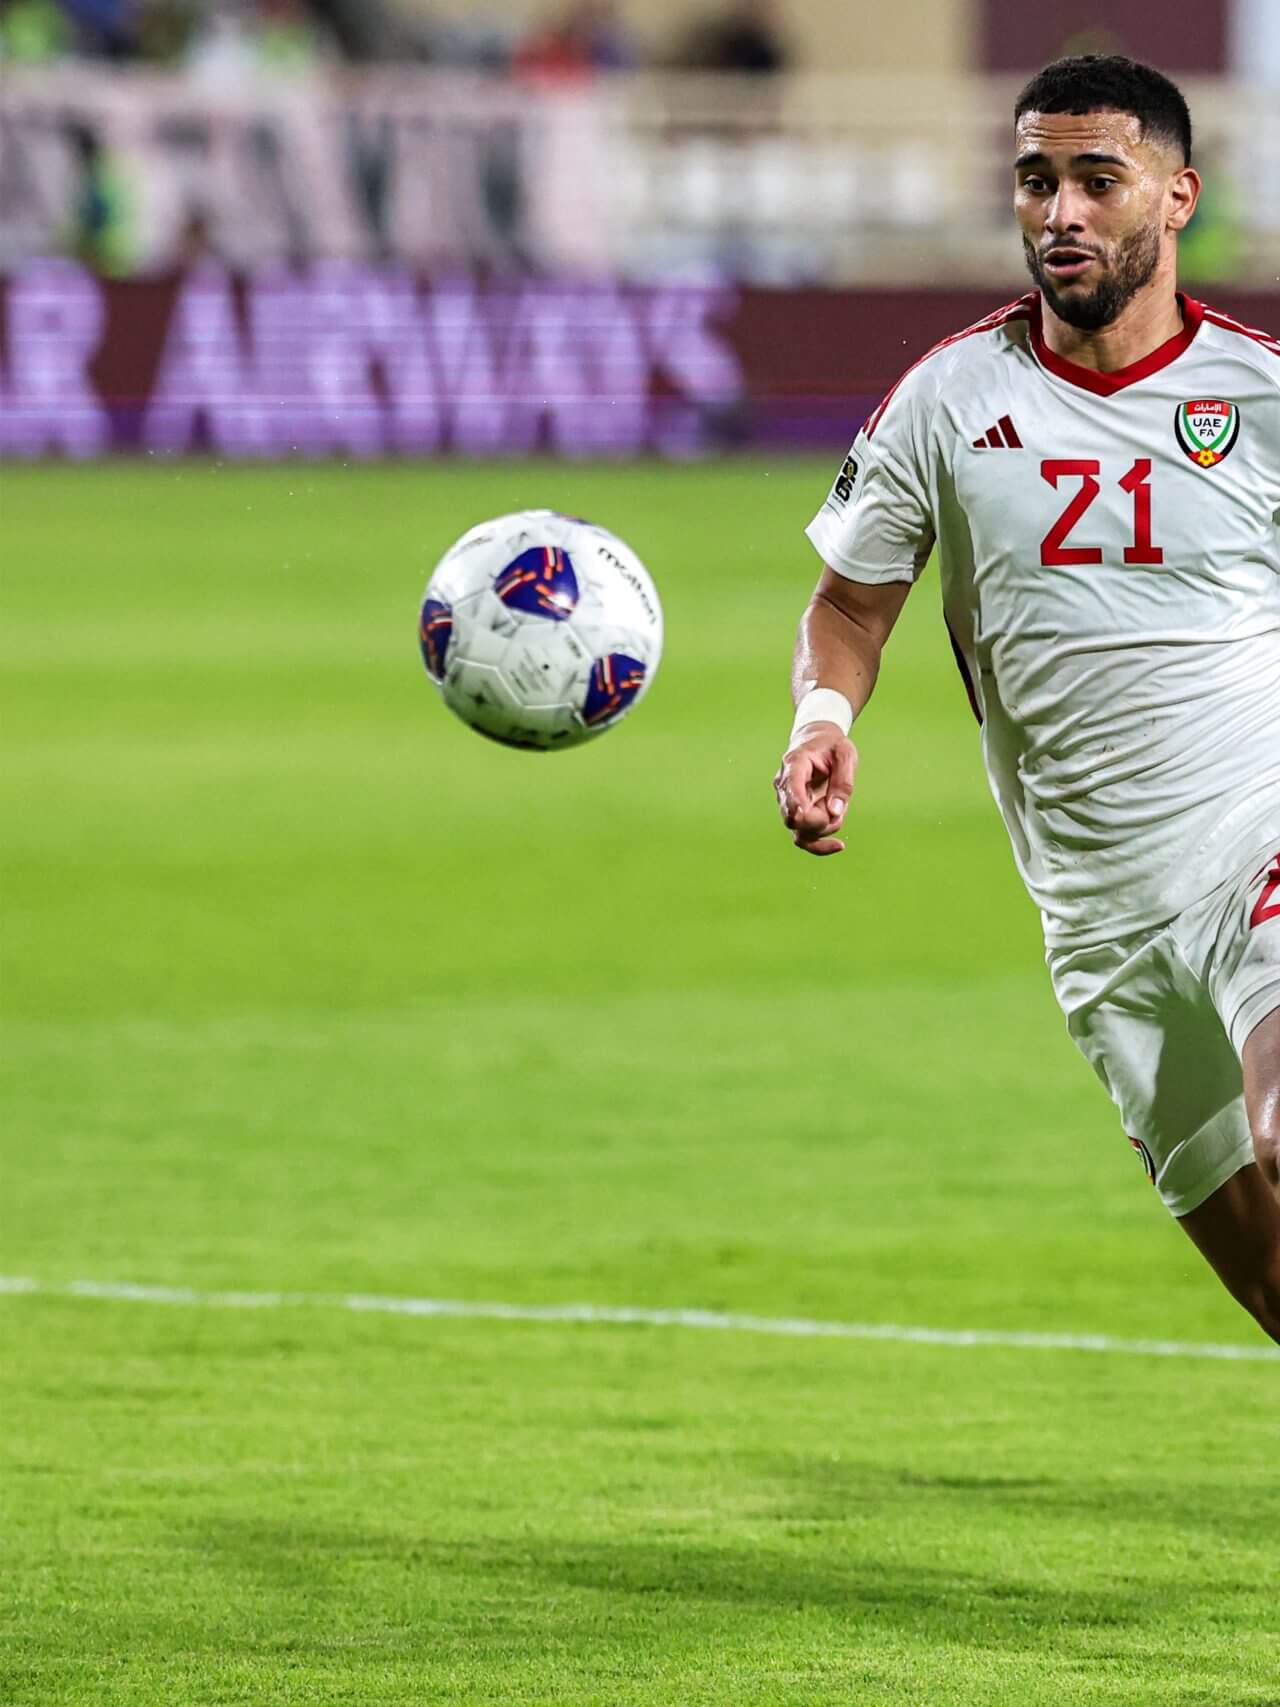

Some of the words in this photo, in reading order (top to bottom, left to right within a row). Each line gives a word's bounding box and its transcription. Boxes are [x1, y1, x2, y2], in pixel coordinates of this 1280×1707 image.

[1193, 417, 1222, 428] UAE
[1199, 428, 1216, 437] FA
[1039, 457, 1164, 567] 21
